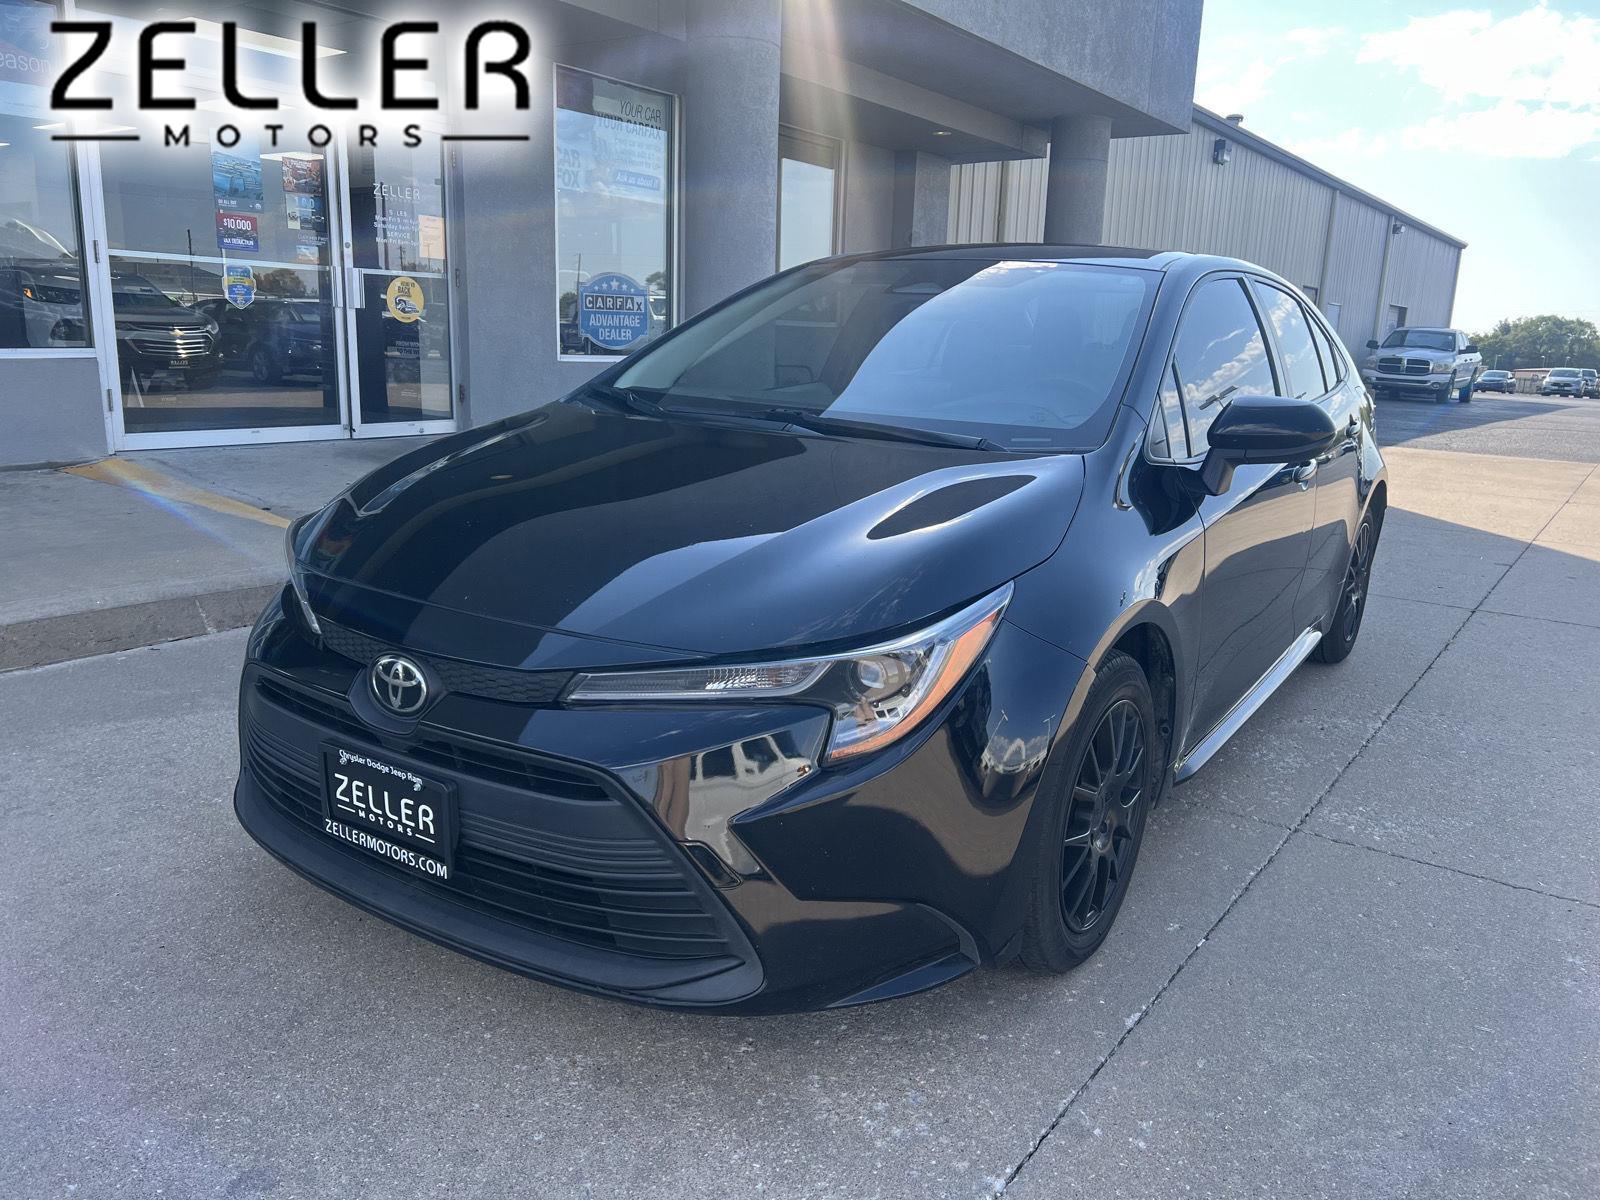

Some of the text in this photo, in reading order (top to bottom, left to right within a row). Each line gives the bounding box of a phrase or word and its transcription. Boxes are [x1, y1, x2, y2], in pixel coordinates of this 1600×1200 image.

[619, 99, 662, 123] YOUR CAR
[597, 112, 662, 141] YOUR CARFAX
[373, 183, 420, 200] ZELLER
[388, 209, 407, 217] SLES
[585, 294, 644, 312] CARFAX
[589, 313, 641, 327] ADVANTAGE
[599, 327, 632, 341] DEALER
[339, 749, 423, 785] Chrysler Dodge Jeep Ram
[334, 773, 435, 835] ZELLER
[358, 809, 413, 837] MOTORS
[325, 818, 448, 880] ZELLERMOTORS.COM
